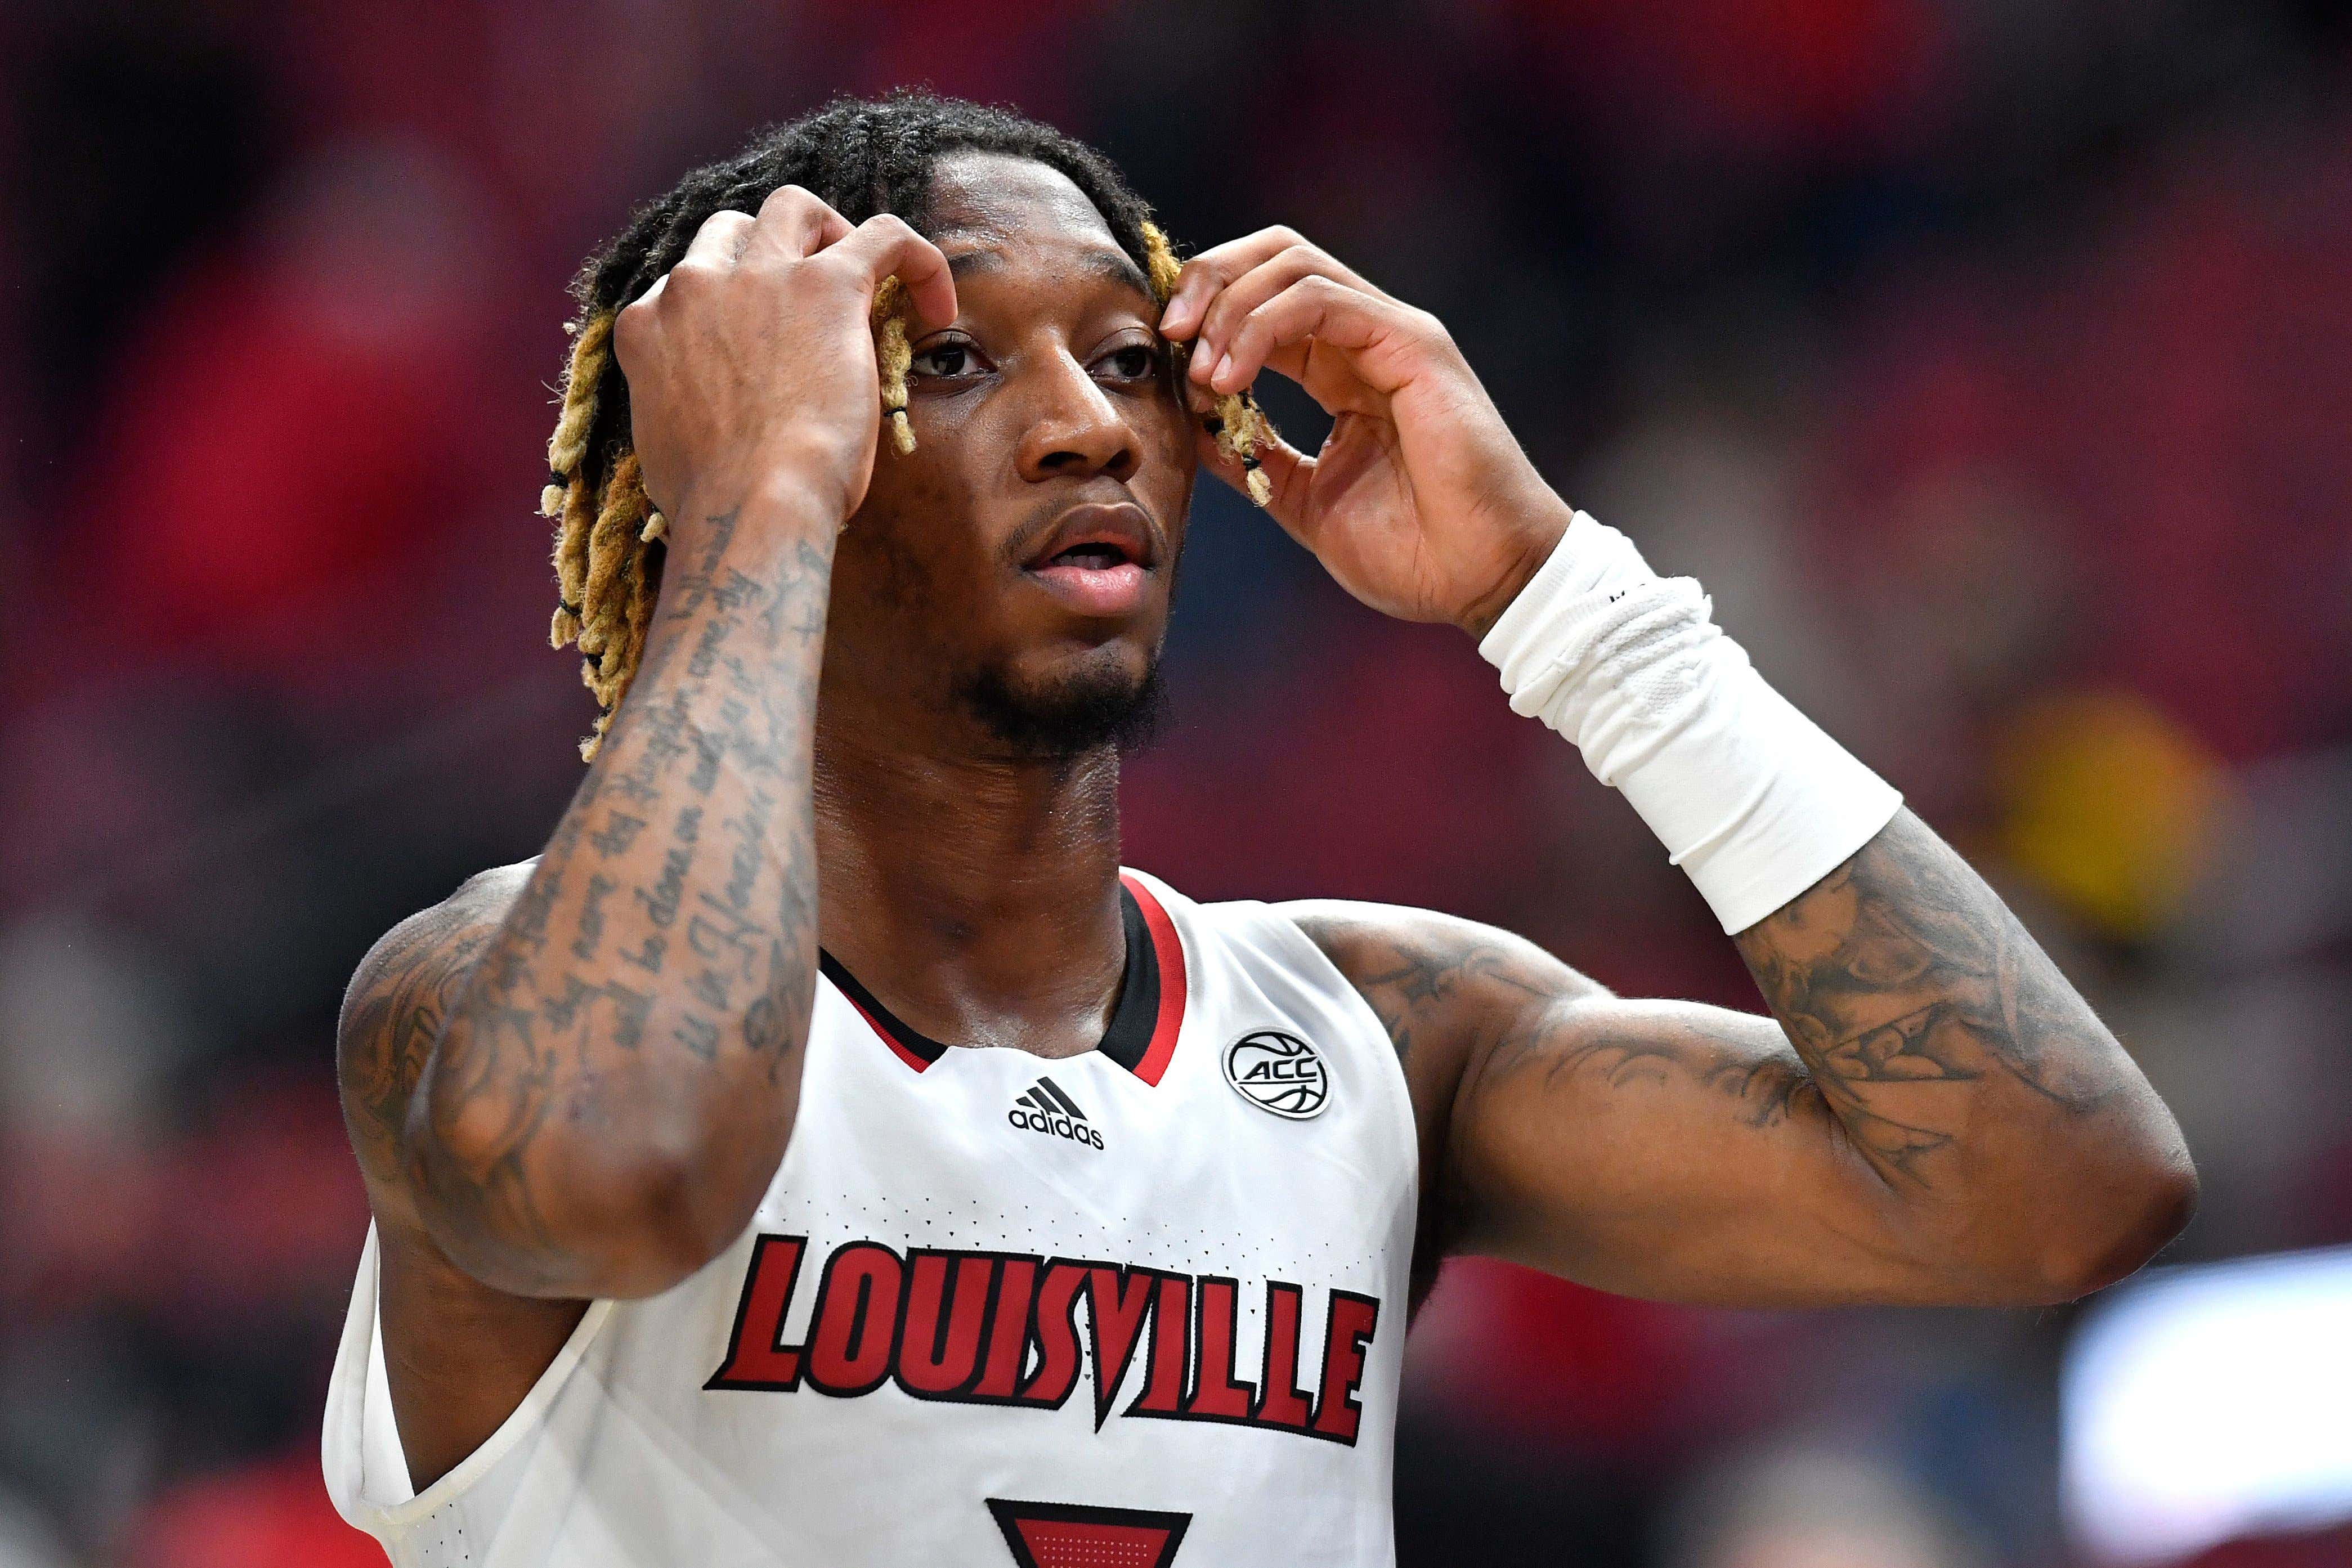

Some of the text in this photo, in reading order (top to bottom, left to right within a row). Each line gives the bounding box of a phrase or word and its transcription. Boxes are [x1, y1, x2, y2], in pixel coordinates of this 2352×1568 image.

[1243, 1056, 1318, 1079] ACC
[1008, 1109, 1104, 1150] adidas
[702, 1233, 1380, 1447] LOUISVILLE
